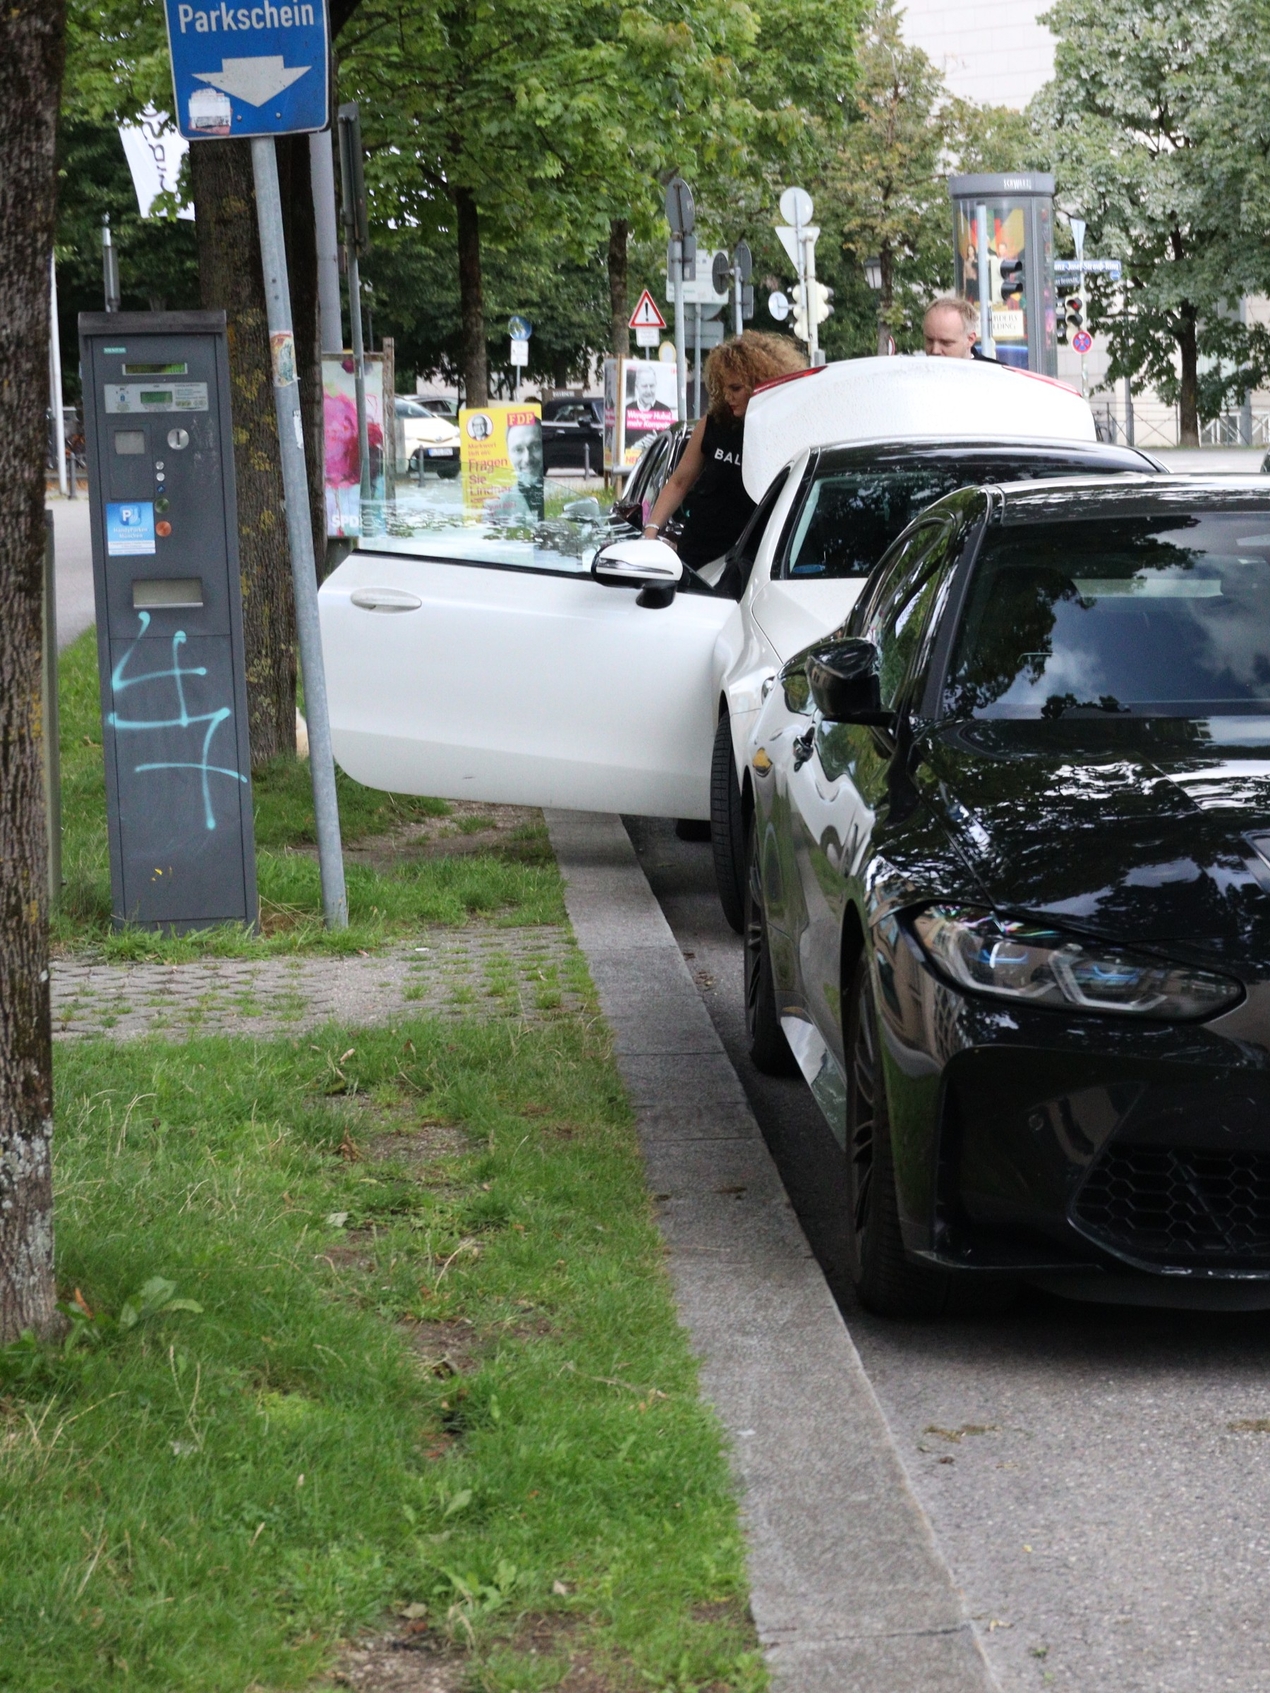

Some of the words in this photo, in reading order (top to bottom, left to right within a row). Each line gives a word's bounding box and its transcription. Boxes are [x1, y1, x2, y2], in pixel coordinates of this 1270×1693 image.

[178, 0, 314, 34] Parkschein
[508, 412, 534, 426] FDP
[469, 458, 508, 469] Fragen
[469, 475, 487, 485] Sie
[331, 514, 360, 528] SPD
